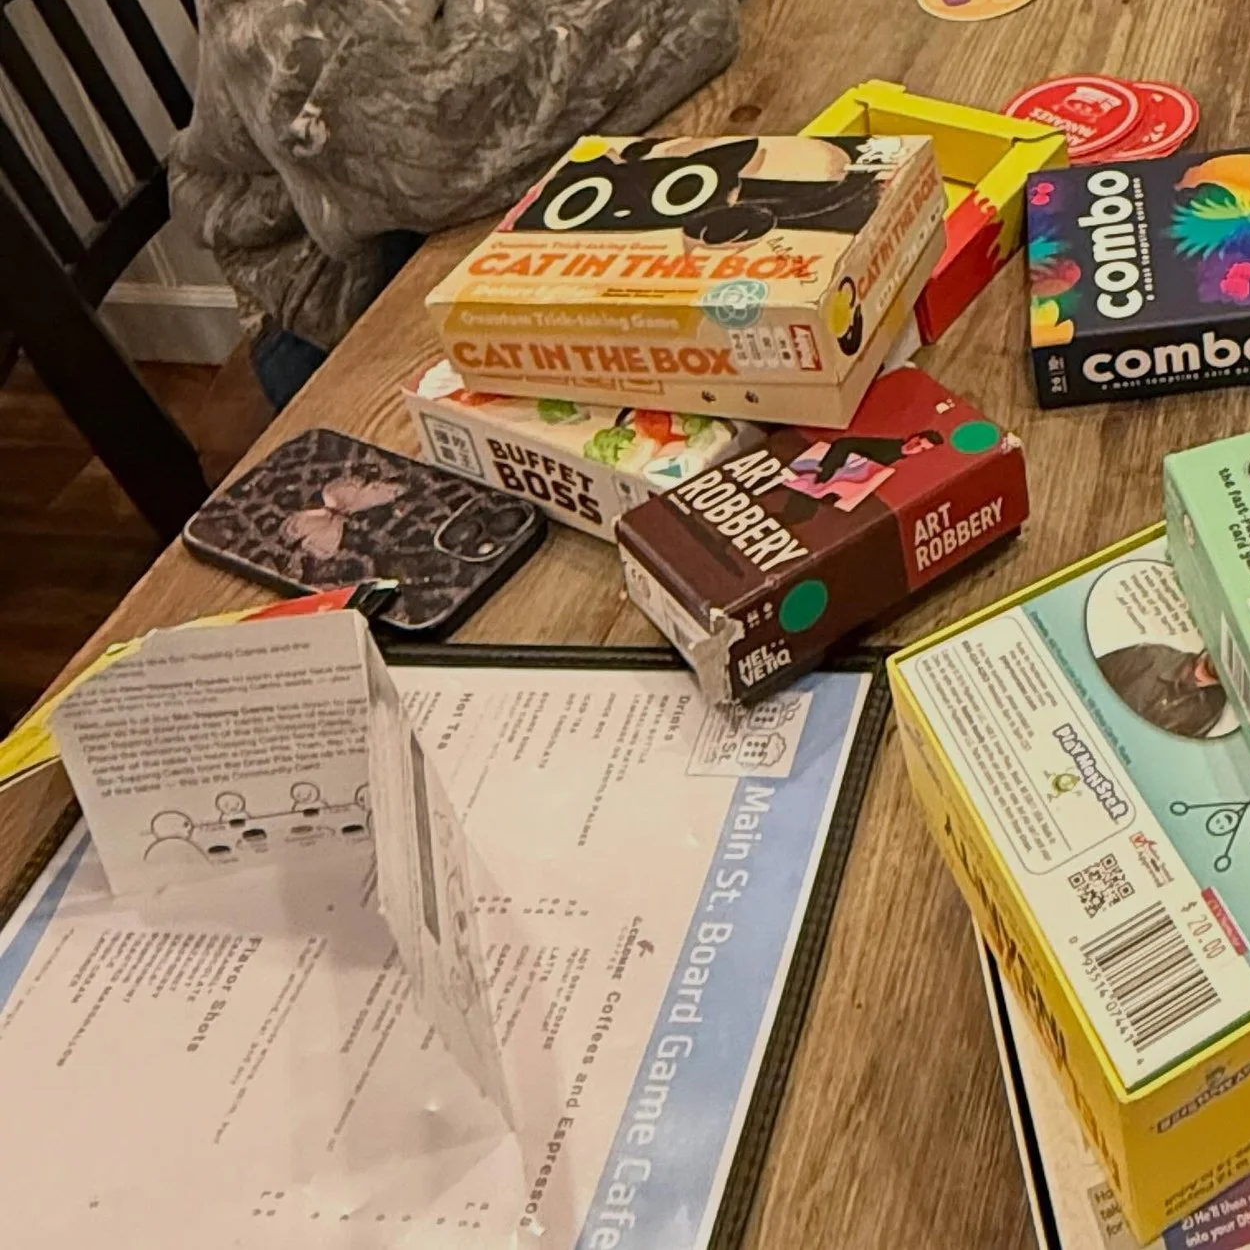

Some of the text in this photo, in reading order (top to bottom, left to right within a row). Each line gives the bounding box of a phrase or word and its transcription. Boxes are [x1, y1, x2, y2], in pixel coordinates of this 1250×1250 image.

[468, 253, 567, 277] CAT
[560, 253, 619, 278] IN
[619, 253, 712, 278] THE
[708, 254, 823, 279] BOX
[1078, 169, 1144, 320] combo
[857, 252, 881, 301] CAT
[453, 342, 738, 376] CAT IN THE BOX
[1204, 368, 1230, 378] card
[486, 438, 594, 494] BUFFET
[723, 450, 799, 496] ART
[1219, 467, 1236, 489] the
[492, 460, 602, 526] BOSS
[677, 469, 809, 572] ROBBERY
[914, 501, 951, 546] ART
[915, 497, 1003, 572] ROBBERY
[1228, 523, 1250, 550] card
[451, 688, 474, 721] Hot
[662, 691, 691, 744] Drinks
[1183, 913, 1229, 962] 20.00
[183, 933, 264, 1057] Flavor Shots
[586, 778, 778, 1250] Main St. Board Game Cafe
[516, 986, 622, 1233] Coffees and Espressos
[1221, 1198, 1248, 1220] then
[1184, 1231, 1209, 1248] into
[1210, 1222, 1237, 1243] your
